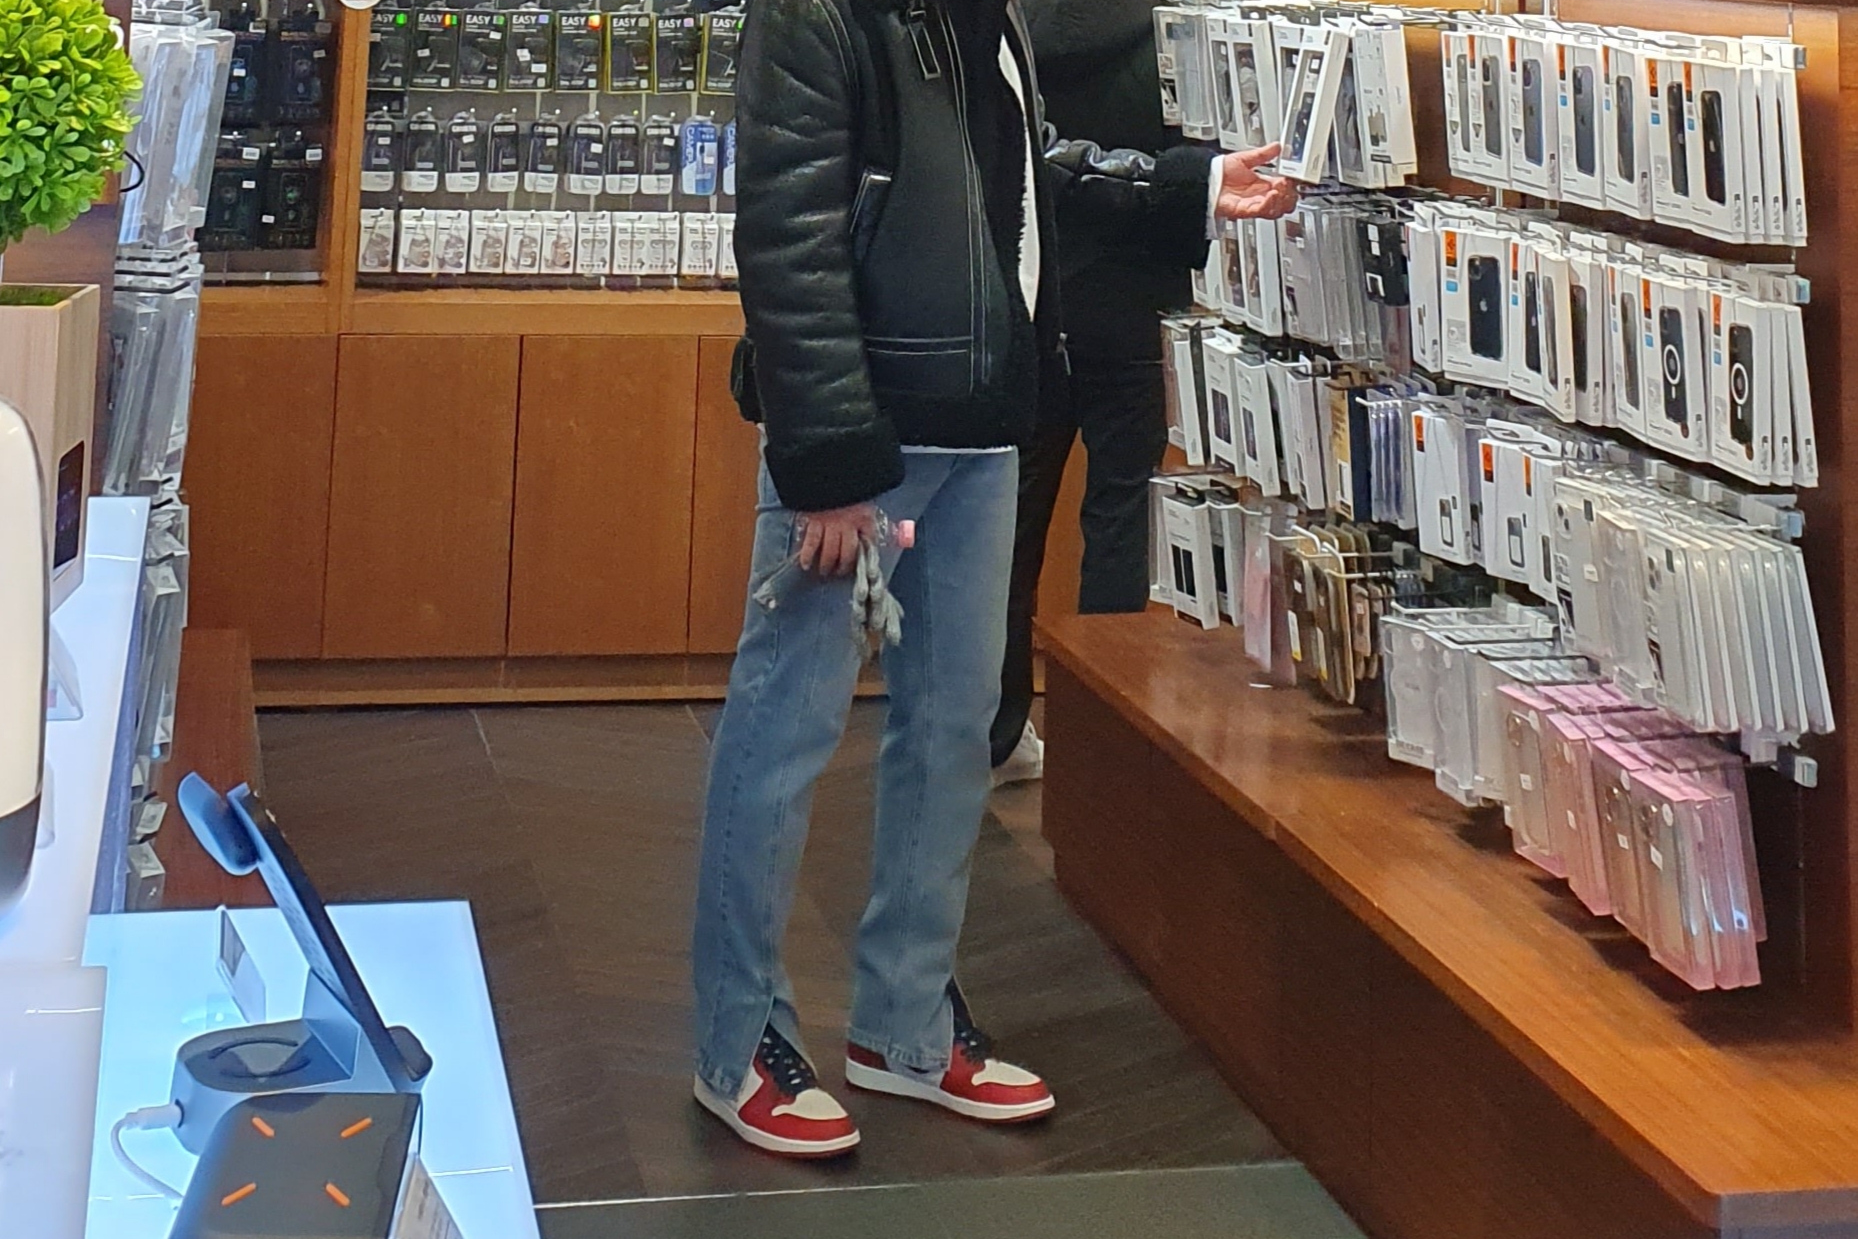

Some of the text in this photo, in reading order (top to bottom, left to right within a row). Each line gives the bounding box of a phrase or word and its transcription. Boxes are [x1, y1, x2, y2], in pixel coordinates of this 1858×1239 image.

[418, 13, 443, 24] EASY
[466, 14, 491, 25] EASY
[512, 14, 537, 24] EASY
[561, 16, 586, 26] EASY
[612, 17, 636, 28] EASY
[658, 18, 681, 29] EASY
[712, 17, 735, 28] EASY
